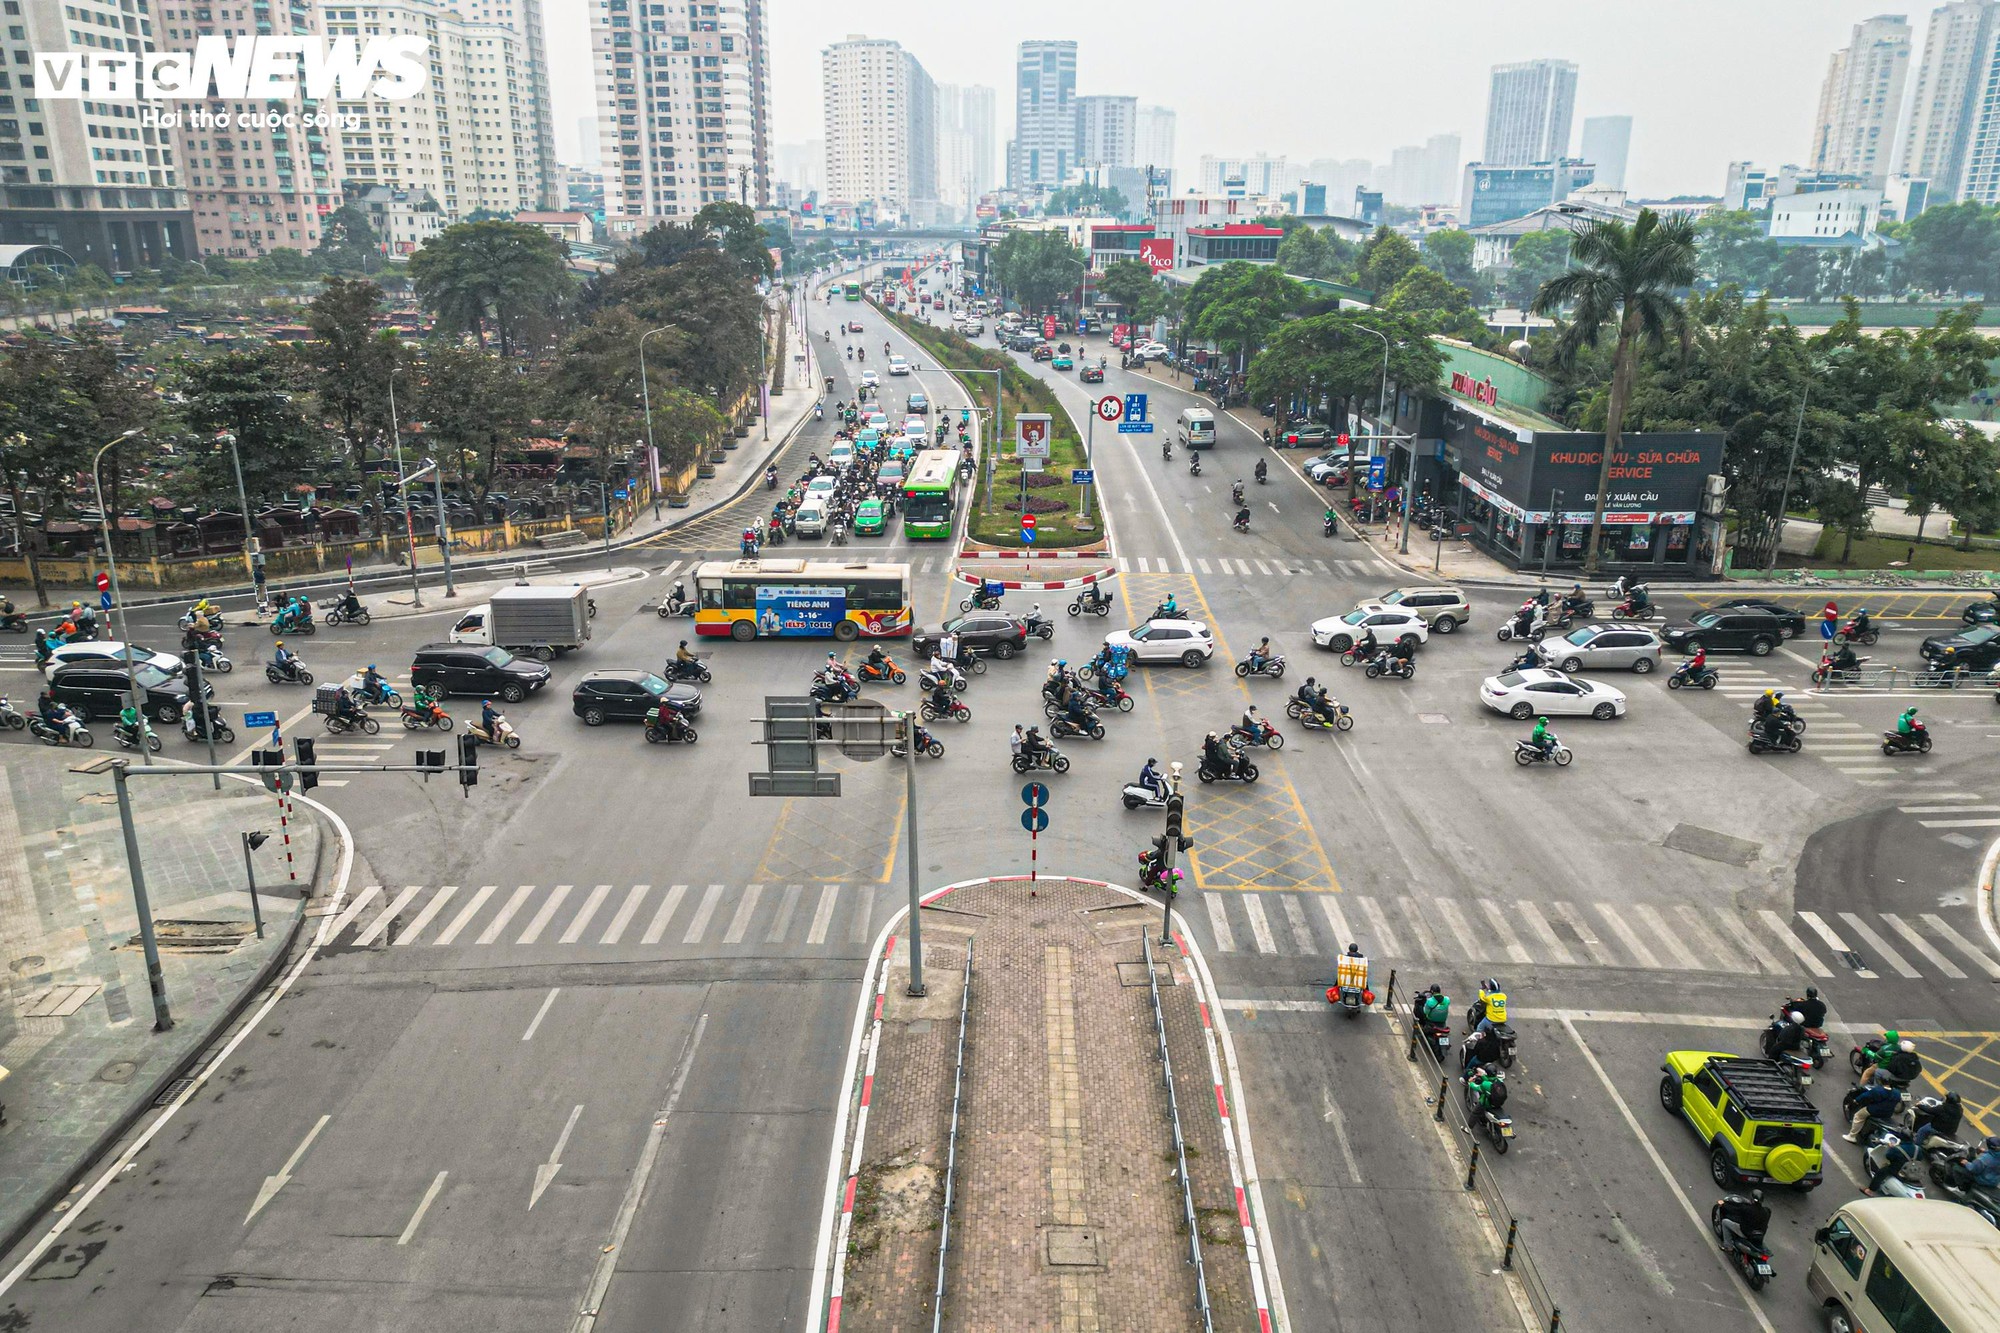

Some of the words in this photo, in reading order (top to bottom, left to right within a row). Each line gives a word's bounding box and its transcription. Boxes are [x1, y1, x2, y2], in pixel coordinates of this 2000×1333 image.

[1451, 370, 1476, 399] XUÂN
[1475, 375, 1498, 407] CẦU
[1550, 452, 1577, 464] KHU
[1611, 452, 1629, 466] VỤ
[1637, 449, 1663, 464] SỬA
[1666, 449, 1700, 464] CHỮA
[1607, 467, 1653, 479] ERVICE
[1614, 492, 1637, 501] XUÂN
[1640, 490, 1659, 501] CẦU
[786, 600, 811, 608] TIẾNG
[1491, 997, 1505, 1008] be
